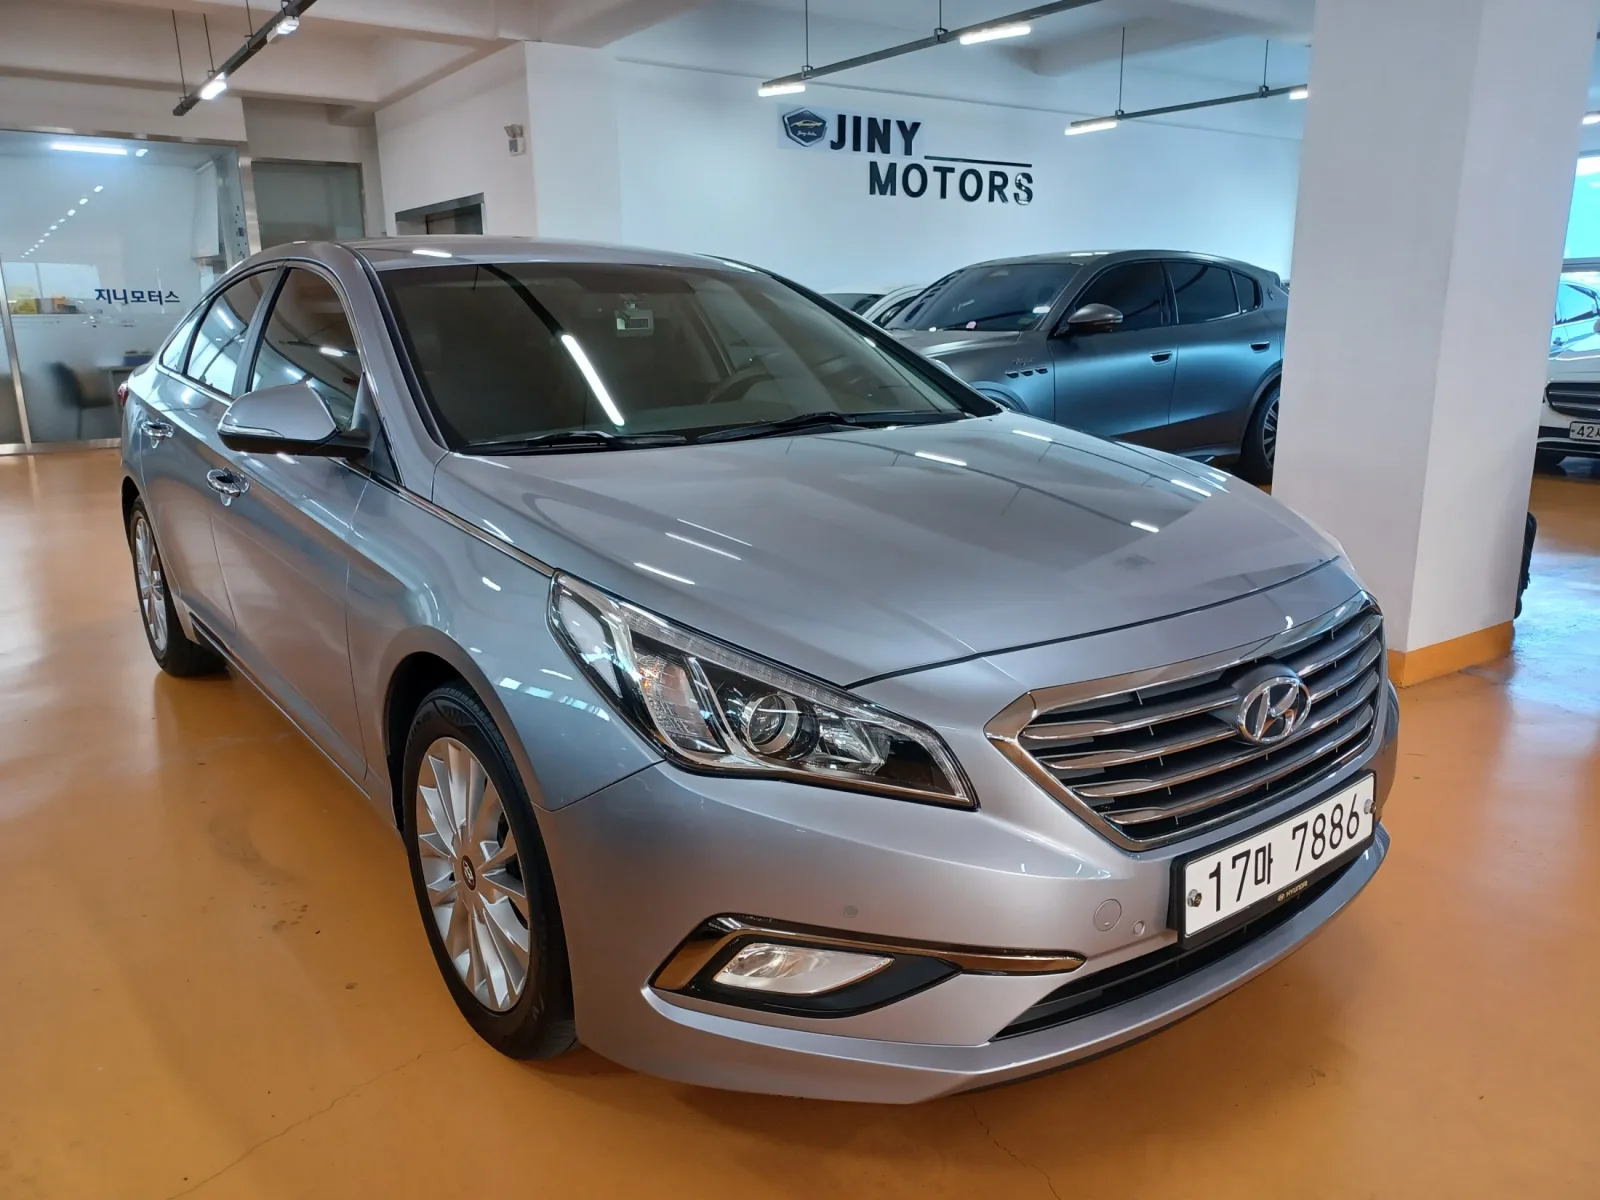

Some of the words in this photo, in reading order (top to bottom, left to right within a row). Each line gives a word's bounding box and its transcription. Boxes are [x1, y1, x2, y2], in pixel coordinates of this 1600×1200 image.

[830, 114, 921, 156] JINY
[869, 161, 1034, 206] MOTORS
[94, 288, 181, 306] 지니모터스
[1208, 842, 1274, 912] 17마
[1291, 793, 1360, 873] 7886
